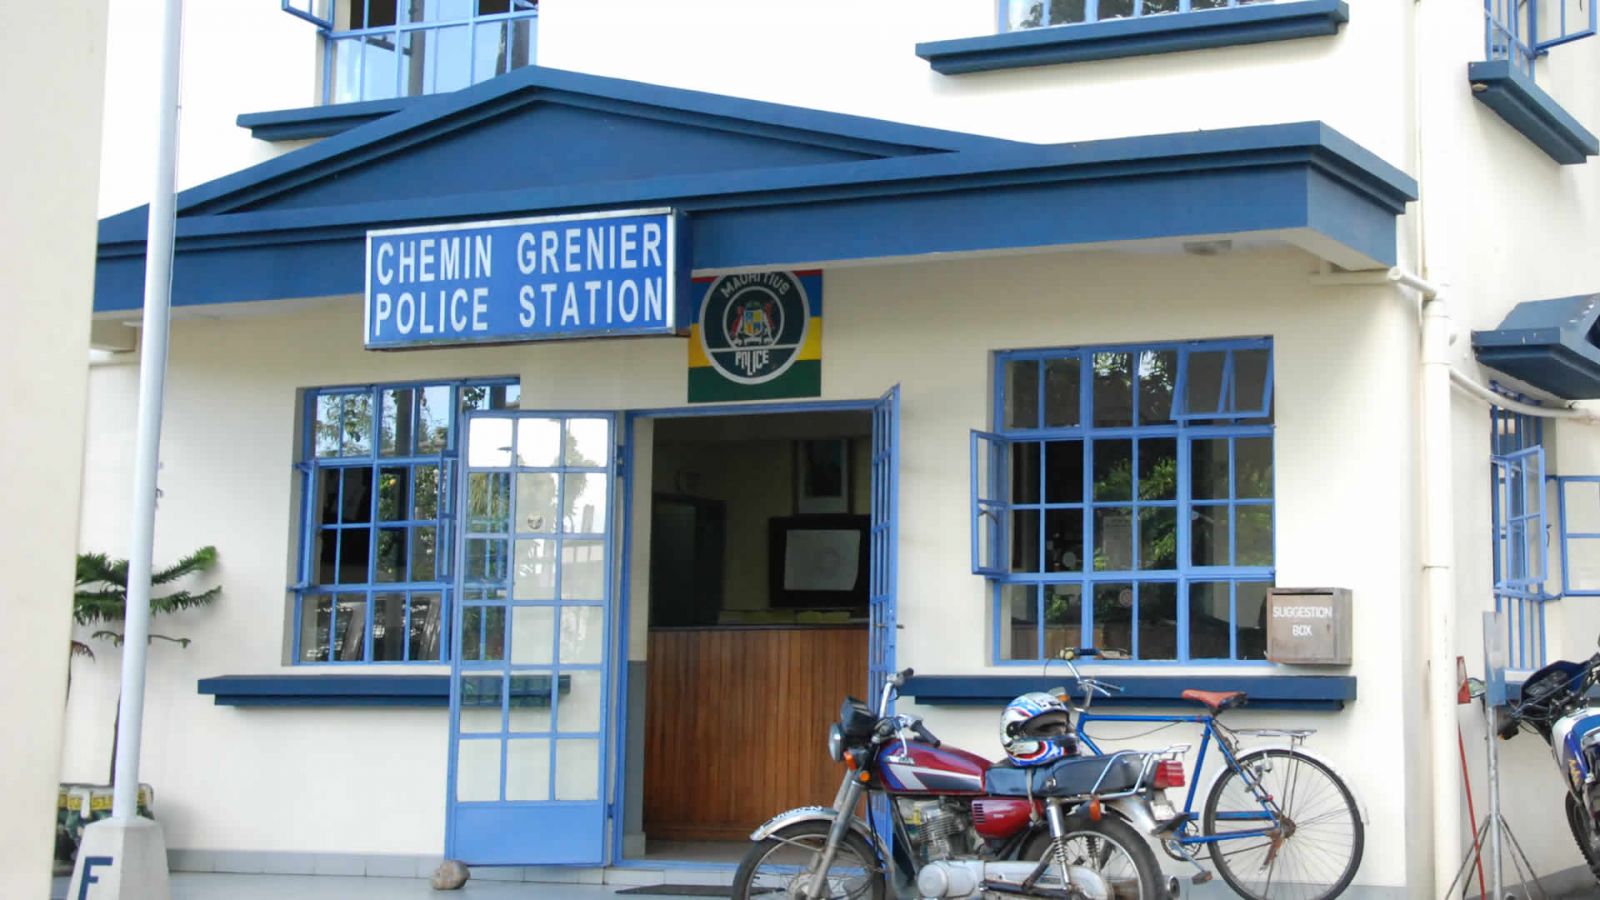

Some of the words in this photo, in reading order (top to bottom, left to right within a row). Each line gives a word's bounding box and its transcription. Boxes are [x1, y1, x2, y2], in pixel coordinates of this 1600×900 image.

[376, 234, 493, 286] CHEMIN
[517, 222, 663, 275] GRENIER
[374, 287, 489, 337] POLICE
[519, 276, 664, 329] STATION
[735, 350, 769, 376] POLICE
[1272, 605, 1333, 618] SUGGESTION
[1292, 624, 1313, 636] BOX
